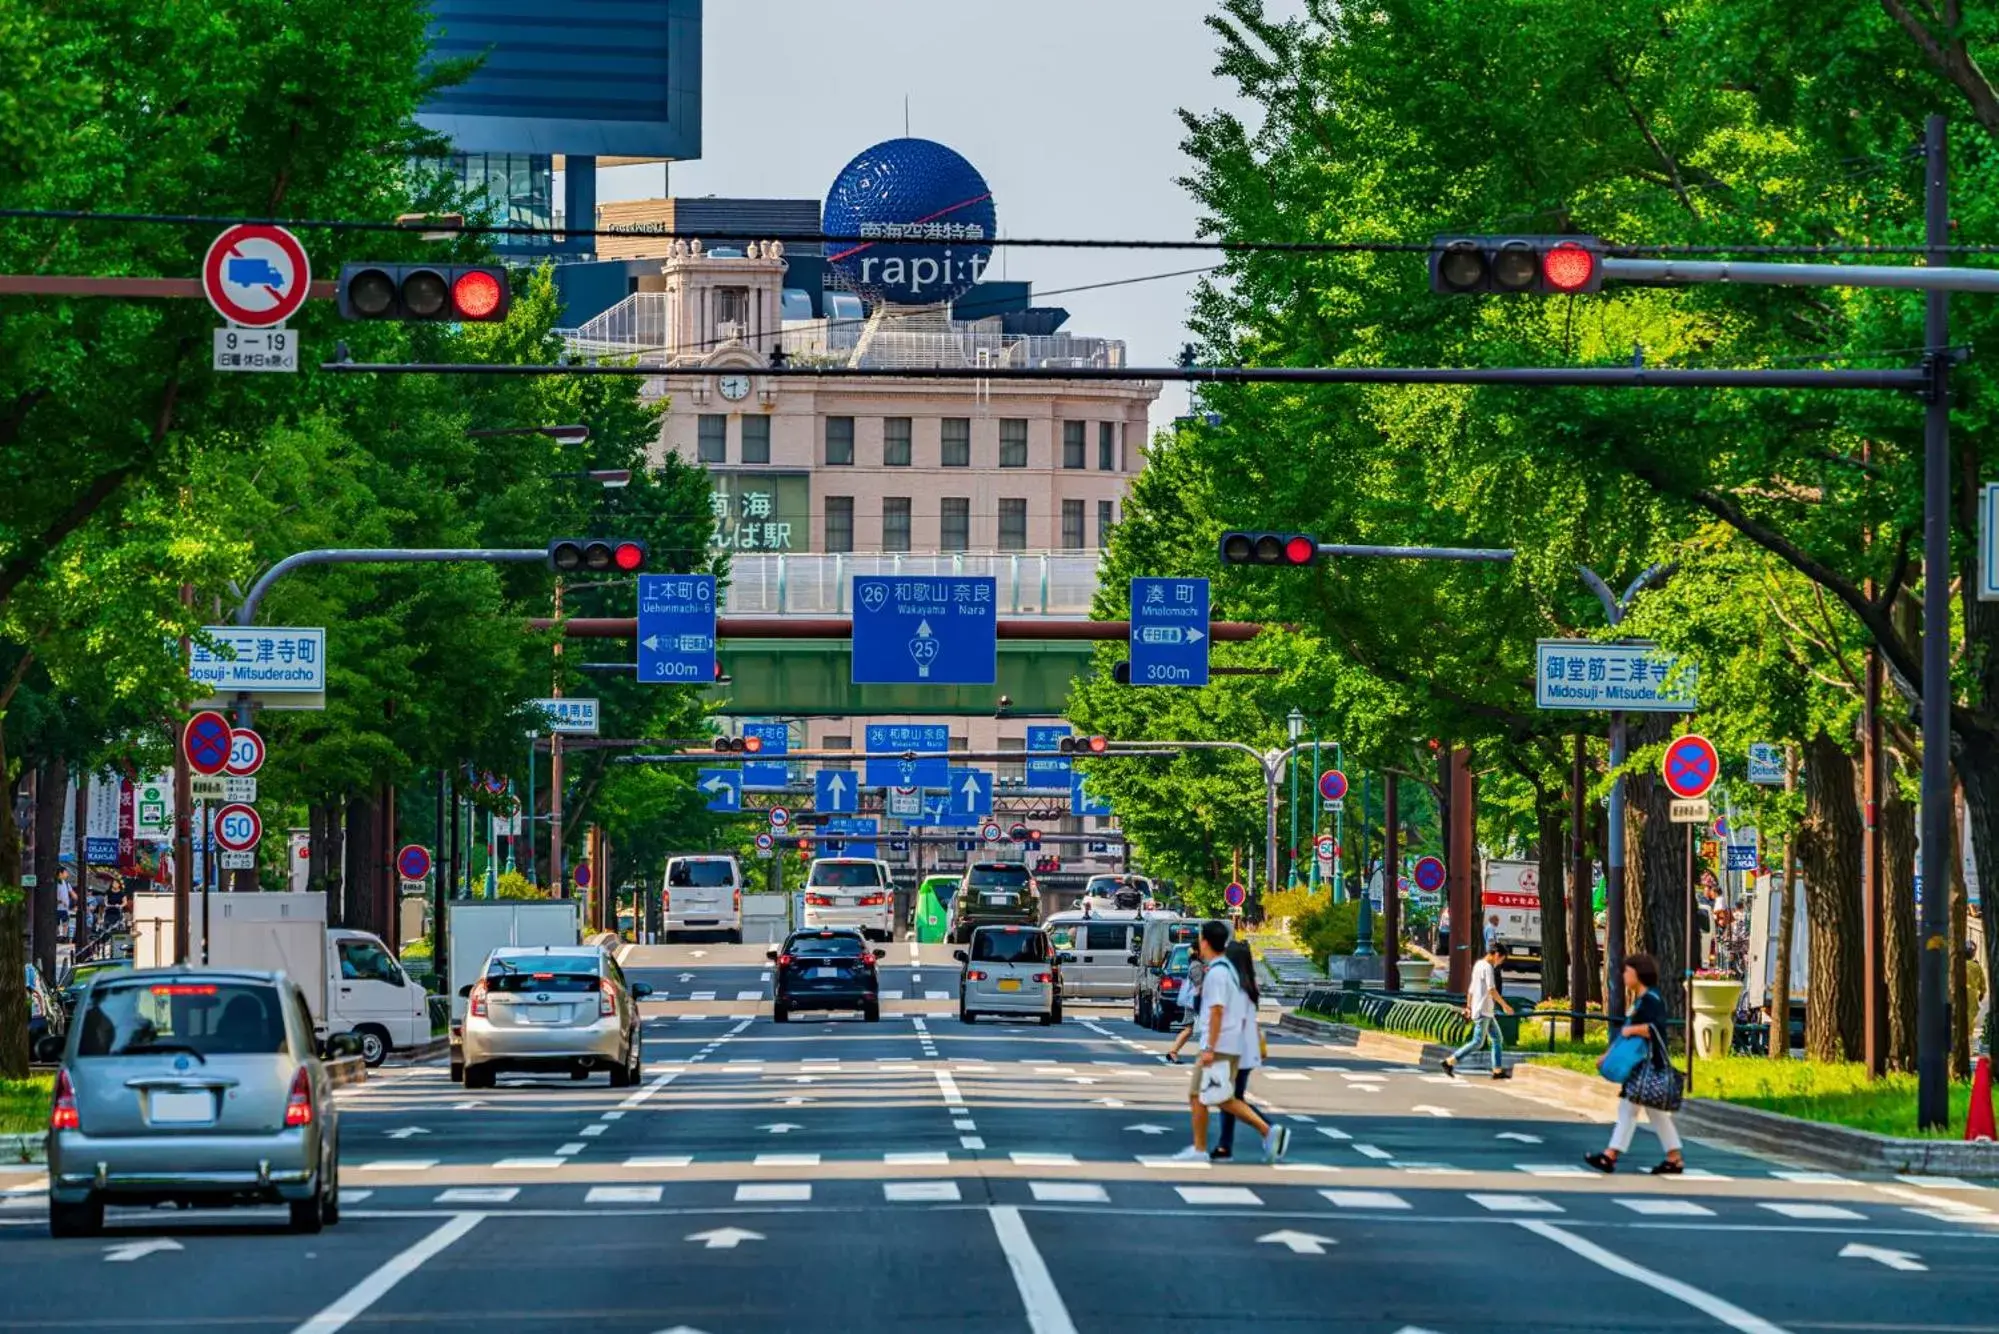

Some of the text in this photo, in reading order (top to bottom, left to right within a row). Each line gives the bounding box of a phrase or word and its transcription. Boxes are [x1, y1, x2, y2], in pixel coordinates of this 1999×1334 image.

[860, 222, 984, 240] 南海空港特急
[709, 522, 791, 549] んば駅
[643, 581, 710, 601] 上本町6
[864, 586, 883, 602] 26
[894, 583, 990, 602] 和歌山 奈良
[898, 605, 985, 616] Wakayama Nara
[192, 638, 316, 663] 堂筋三津寺町
[915, 641, 934, 657] 25
[189, 666, 314, 681] dosuji-Mitsuderacho
[656, 662, 698, 676] 300m
[1147, 664, 1190, 679] 300m
[224, 817, 251, 838] 50
